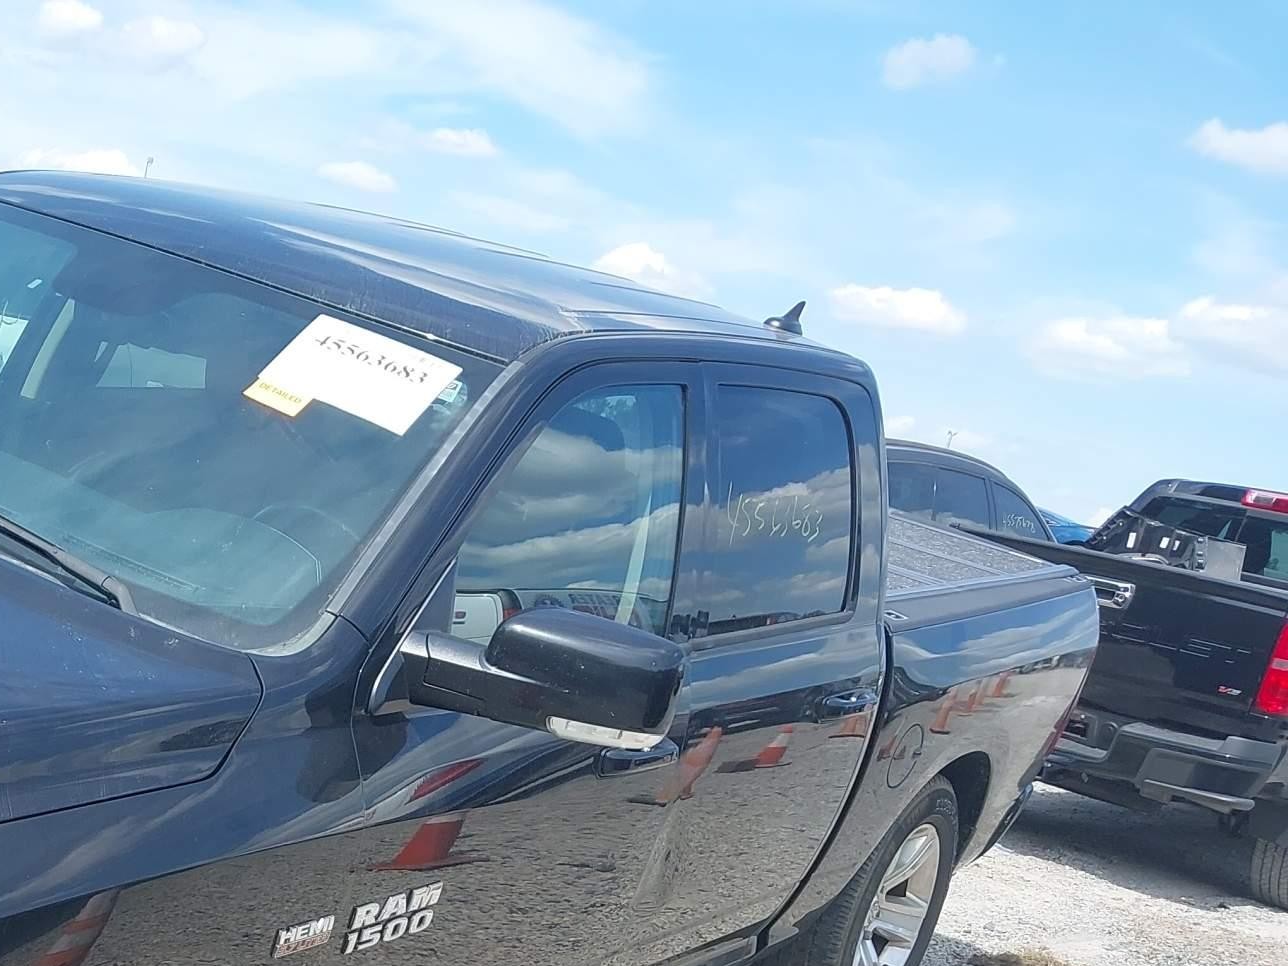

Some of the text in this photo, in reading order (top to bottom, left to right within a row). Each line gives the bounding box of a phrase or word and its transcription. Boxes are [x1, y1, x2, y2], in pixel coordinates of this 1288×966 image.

[314, 335, 428, 384] 45563683
[348, 880, 444, 931] RAM
[276, 914, 335, 945] HEMI
[342, 909, 434, 955] 1500
